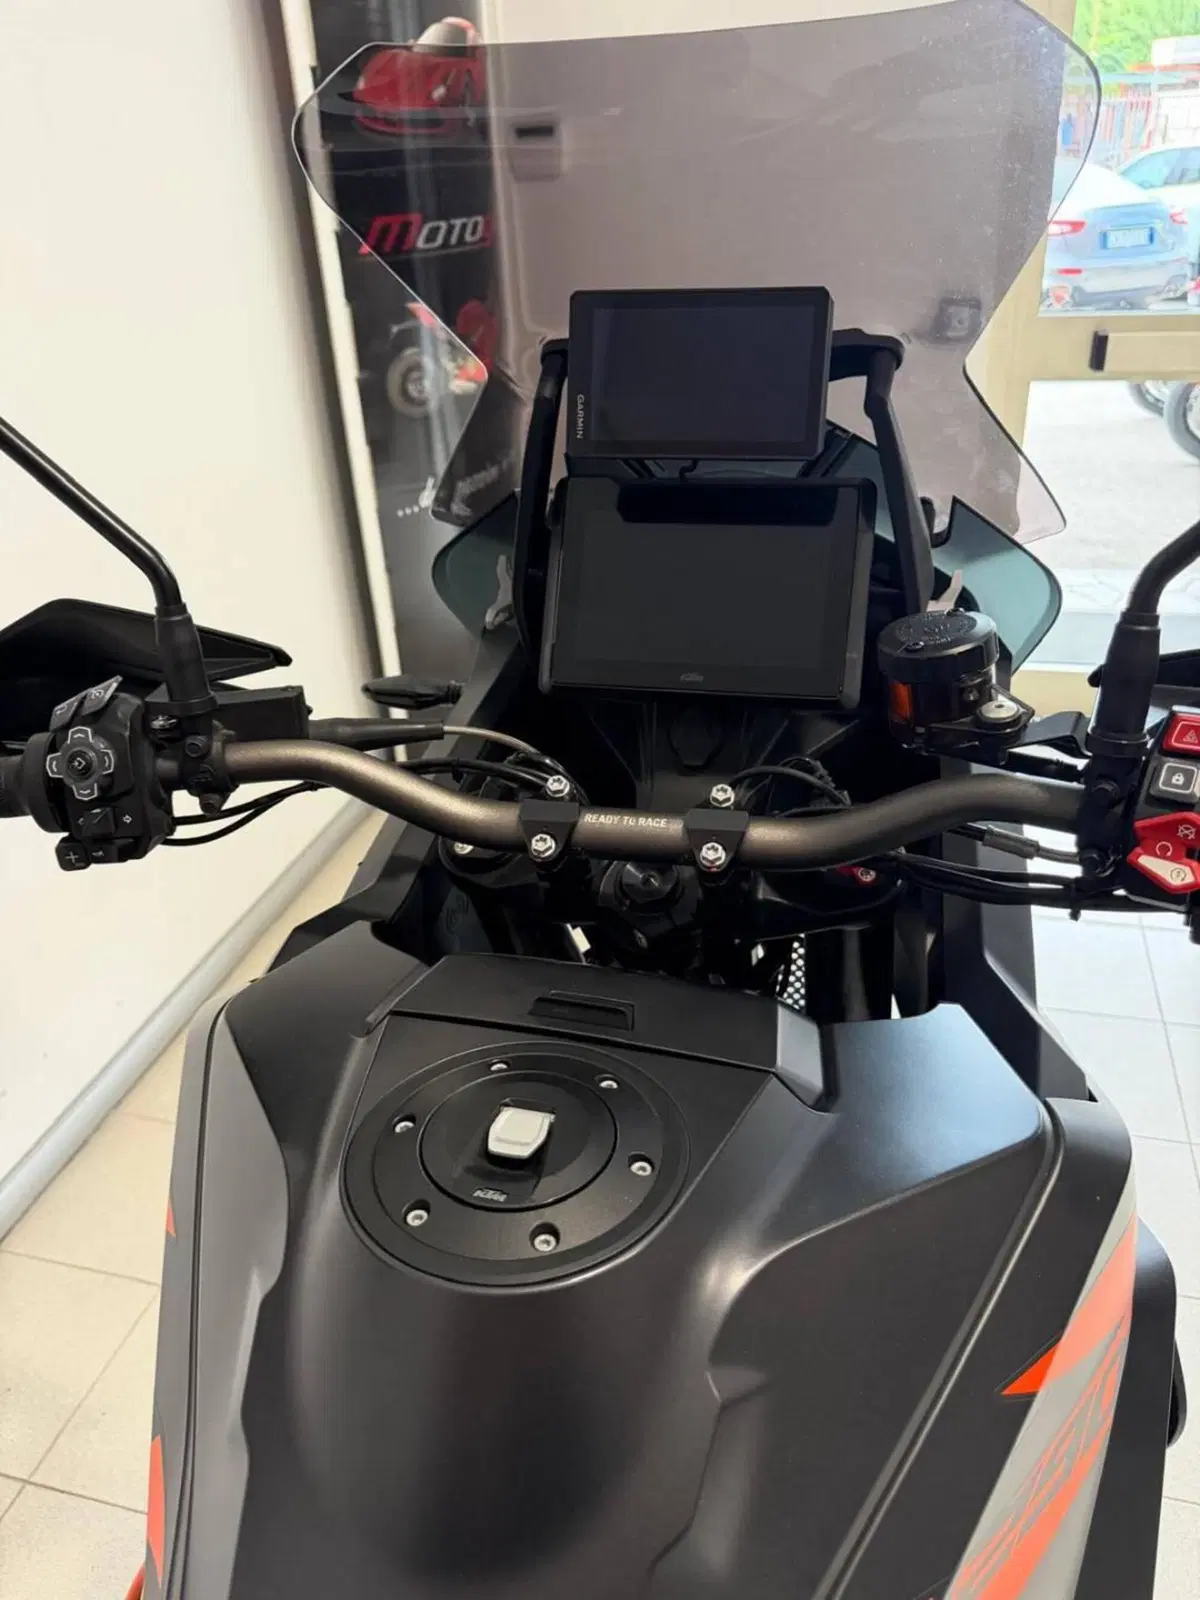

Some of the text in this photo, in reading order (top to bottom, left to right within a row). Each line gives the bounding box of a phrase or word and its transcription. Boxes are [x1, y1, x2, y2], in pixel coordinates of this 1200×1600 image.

[576, 394, 585, 439] GARMIN
[584, 813, 668, 828] READY TO RACE
